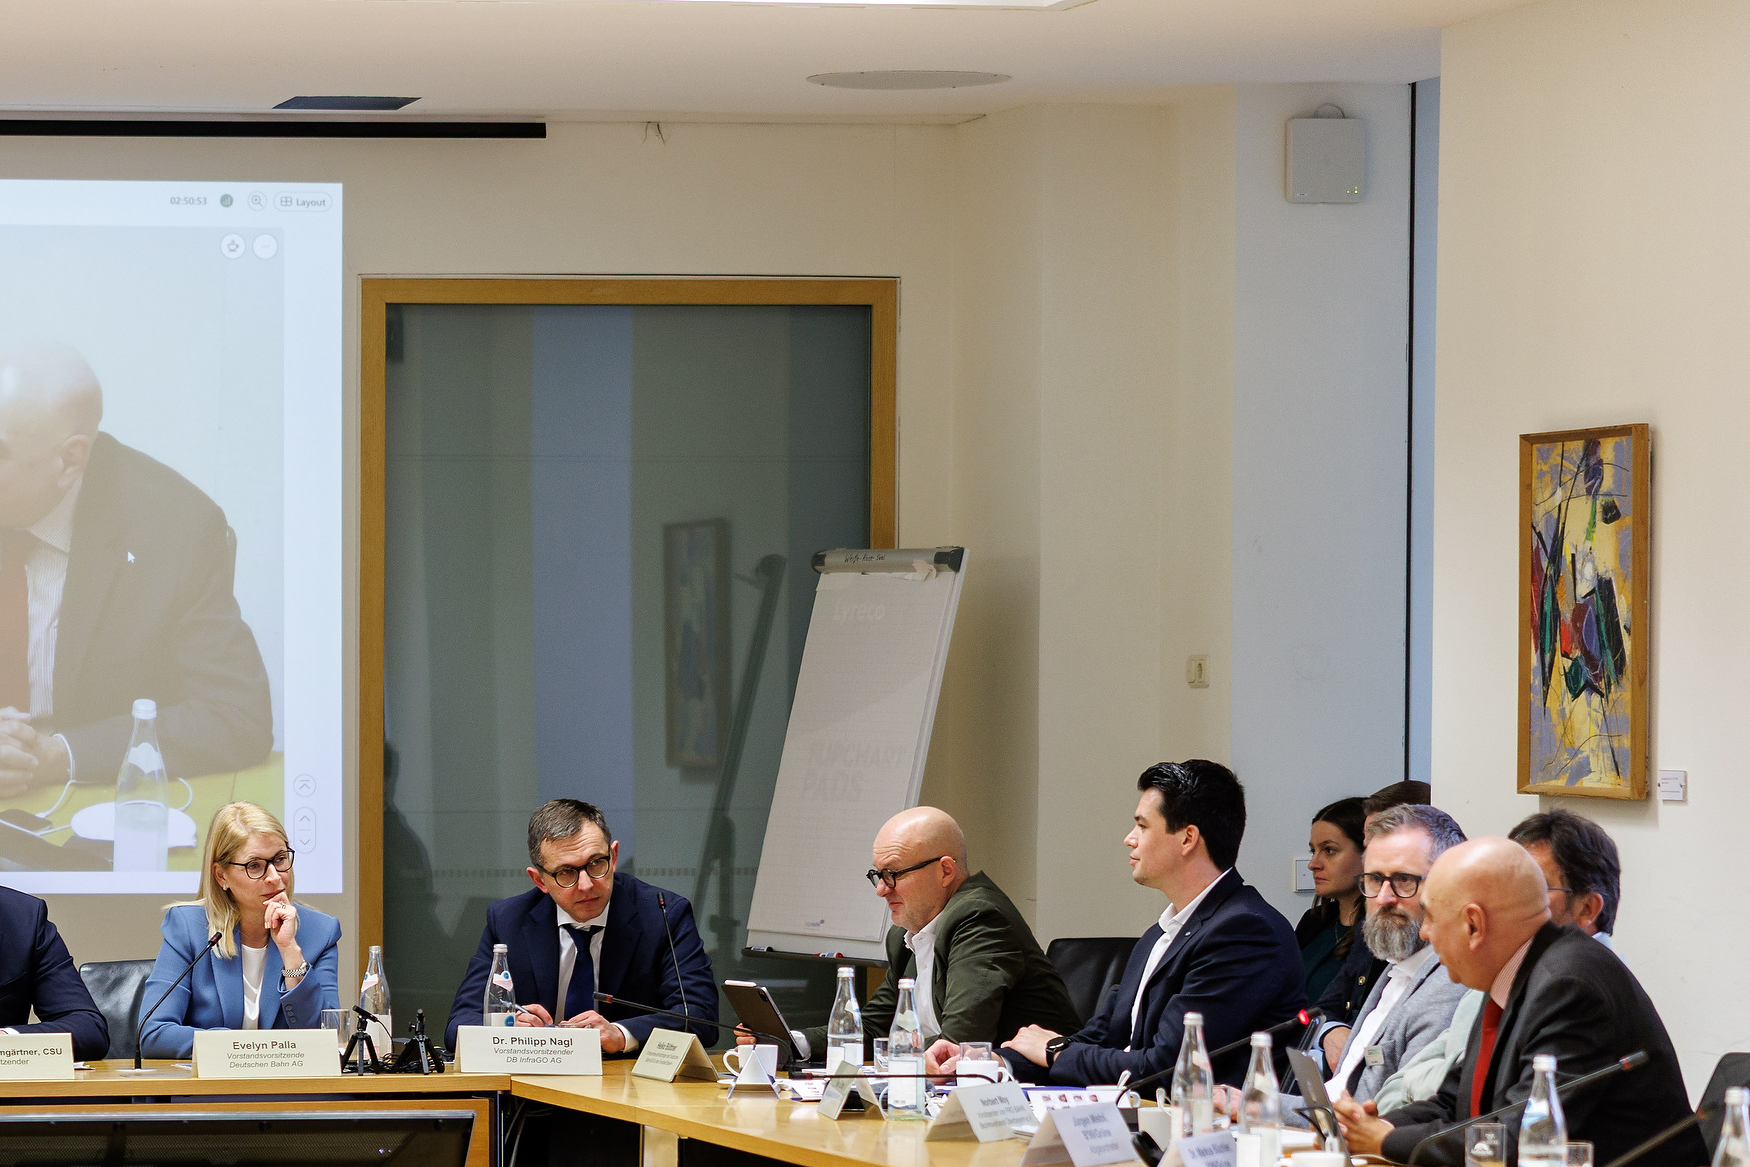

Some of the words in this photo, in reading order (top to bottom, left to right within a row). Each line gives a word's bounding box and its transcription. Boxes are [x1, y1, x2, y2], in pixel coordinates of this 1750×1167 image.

[296, 197, 326, 207] Layout
[232, 1041, 268, 1052] Evelyn
[271, 1040, 297, 1049] Palla
[492, 1036, 508, 1045] Dr.
[510, 1037, 547, 1048] Philipp
[549, 1037, 573, 1048] Nagl
[42, 1047, 63, 1056] CSU
[226, 1052, 305, 1060] Vorstandsvorsitzende
[493, 1047, 574, 1056] Vorstandsvorsitzender
[229, 1061, 269, 1069] Deutschen
[270, 1060, 290, 1068] Bahn
